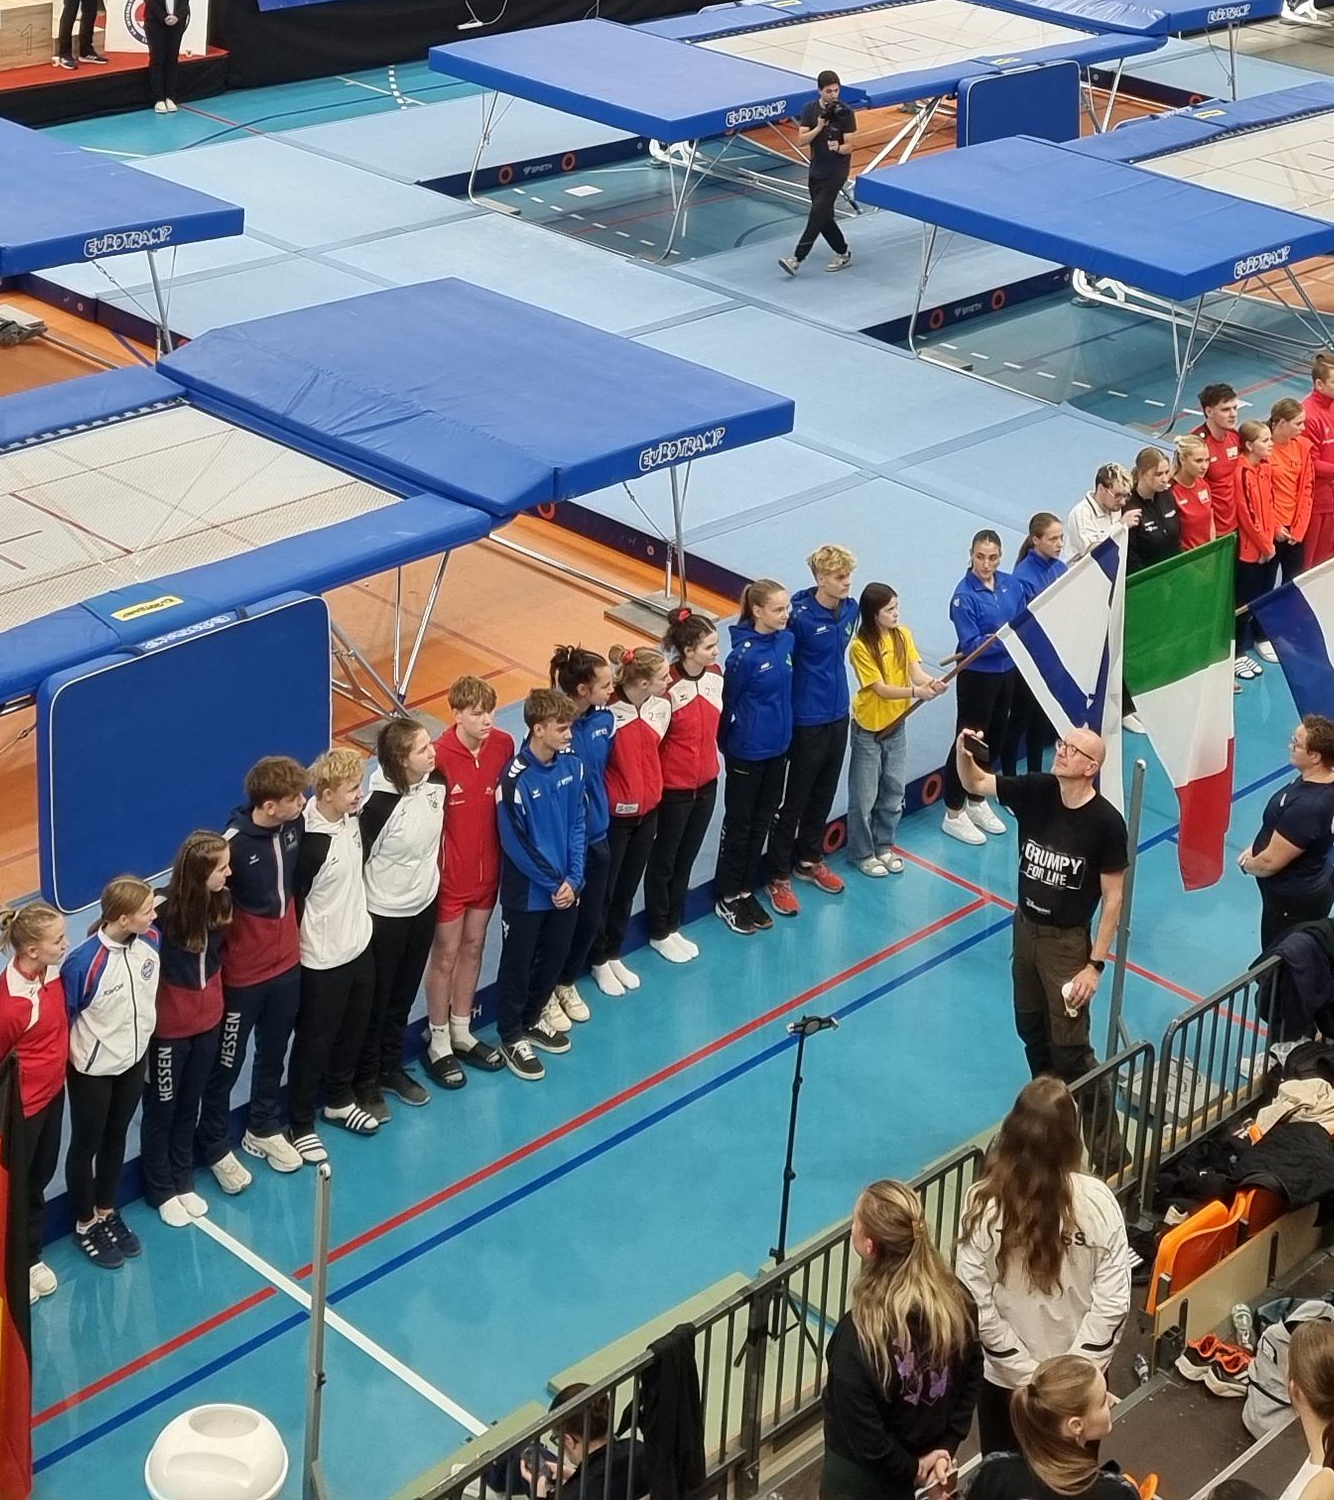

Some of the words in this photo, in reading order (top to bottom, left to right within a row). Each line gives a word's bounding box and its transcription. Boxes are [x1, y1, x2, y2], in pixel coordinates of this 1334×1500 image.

[20, 23, 33, 56] 1
[725, 100, 787, 128] EUROTRAMP
[83, 225, 172, 258] EUROTRAMP
[639, 427, 726, 472] EUROTRAMP
[1024, 842, 1083, 876] GRUMPY
[1027, 862, 1045, 880] FOR
[219, 1011, 242, 1069] HESSEN
[157, 1046, 174, 1102] HESSEN
